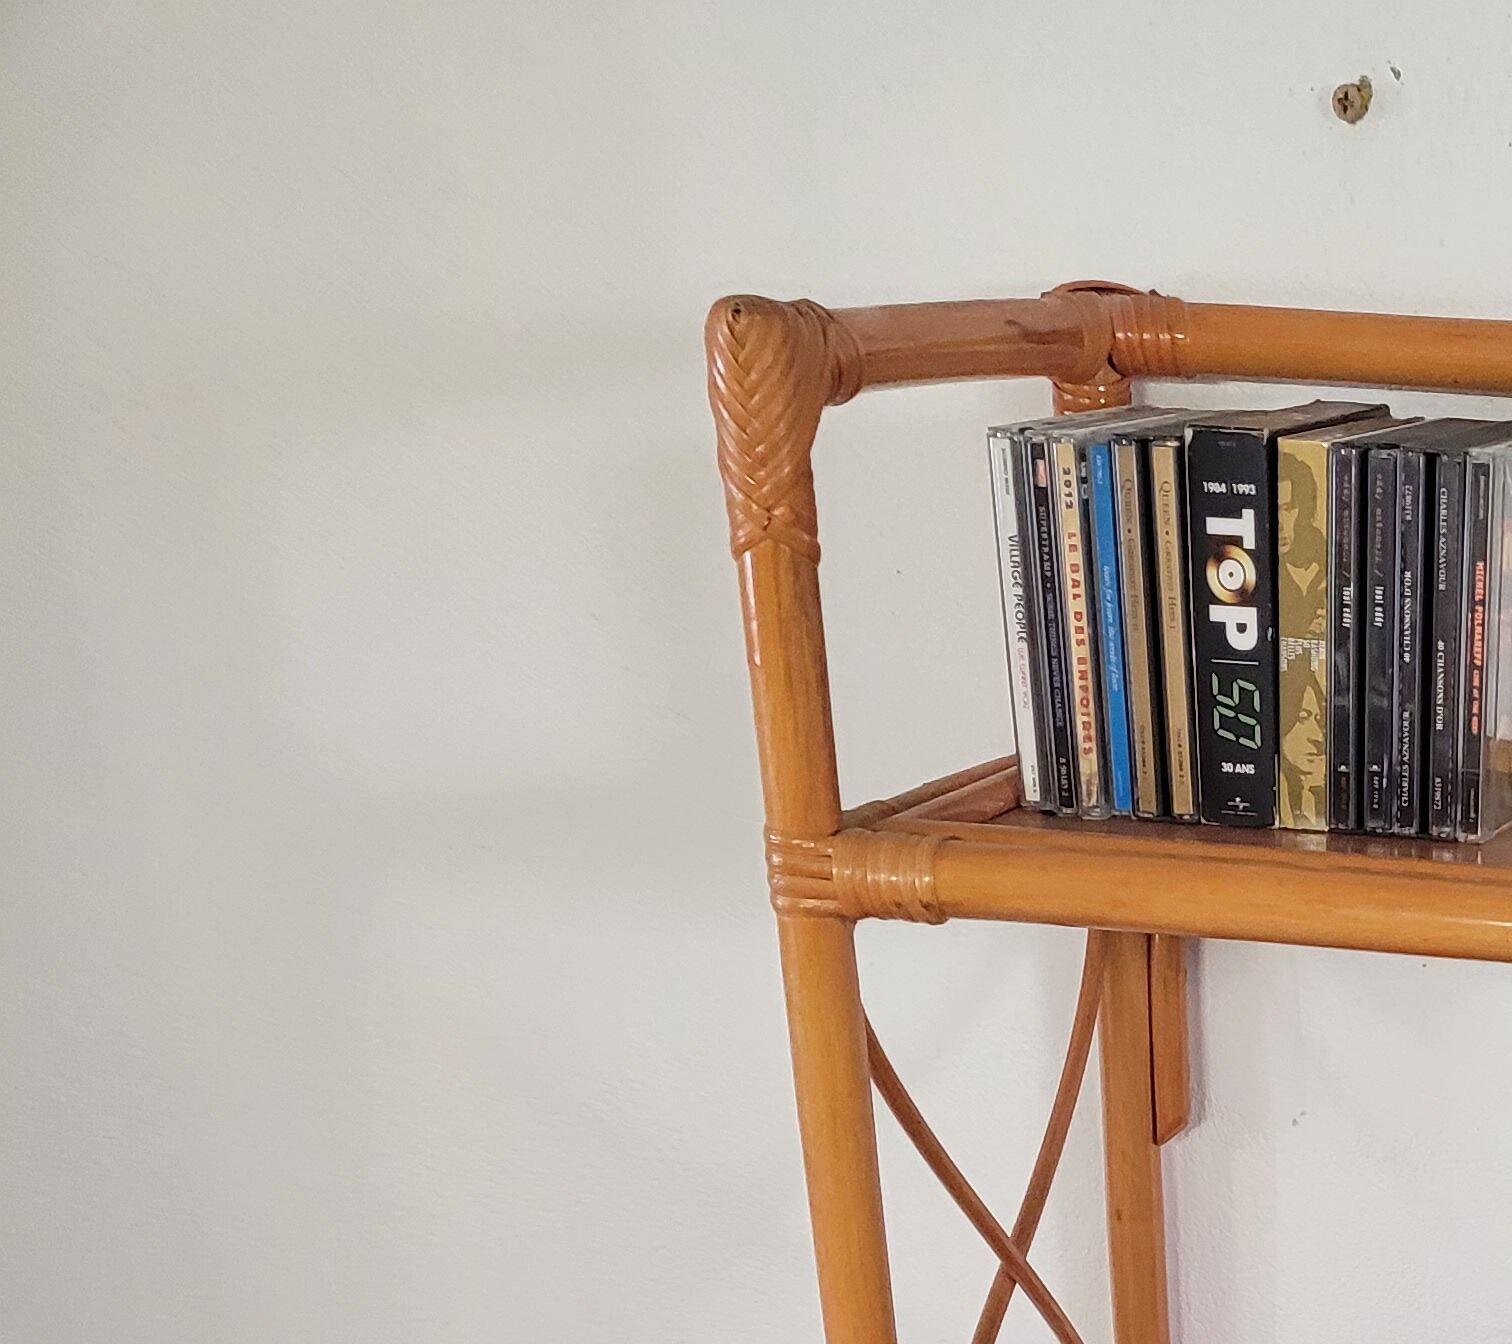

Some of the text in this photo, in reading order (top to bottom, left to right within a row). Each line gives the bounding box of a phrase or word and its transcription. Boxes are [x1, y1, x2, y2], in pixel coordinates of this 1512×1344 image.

[1062, 467, 1075, 510] 2012
[1158, 480, 1172, 526] QUEEN
[1202, 481, 1256, 496] 1984 1993
[1438, 487, 1448, 533] CHARLES
[1007, 534, 1023, 588] VILLAGE
[1038, 505, 1052, 578] SUPERTRAMP
[1067, 532, 1078, 552] LE
[1438, 534, 1448, 591] AZNAVOUR
[1070, 563, 1082, 601] BAL
[1205, 508, 1259, 651] TOP
[1474, 561, 1485, 602] MICHEL
[1014, 595, 1028, 644] PEOPLE
[1074, 611, 1086, 648] DES
[1373, 606, 1385, 628] eddy
[1473, 605, 1484, 667] POLNAREFF
[1437, 640, 1445, 651] 40
[1401, 570, 1413, 807] CHARLES AZNAVOUR 40 CHANSONS D'OR
[1436, 652, 1445, 705] CHANSONS
[1211, 672, 1262, 750] 50
[1221, 761, 1256, 775] 30 ANS
